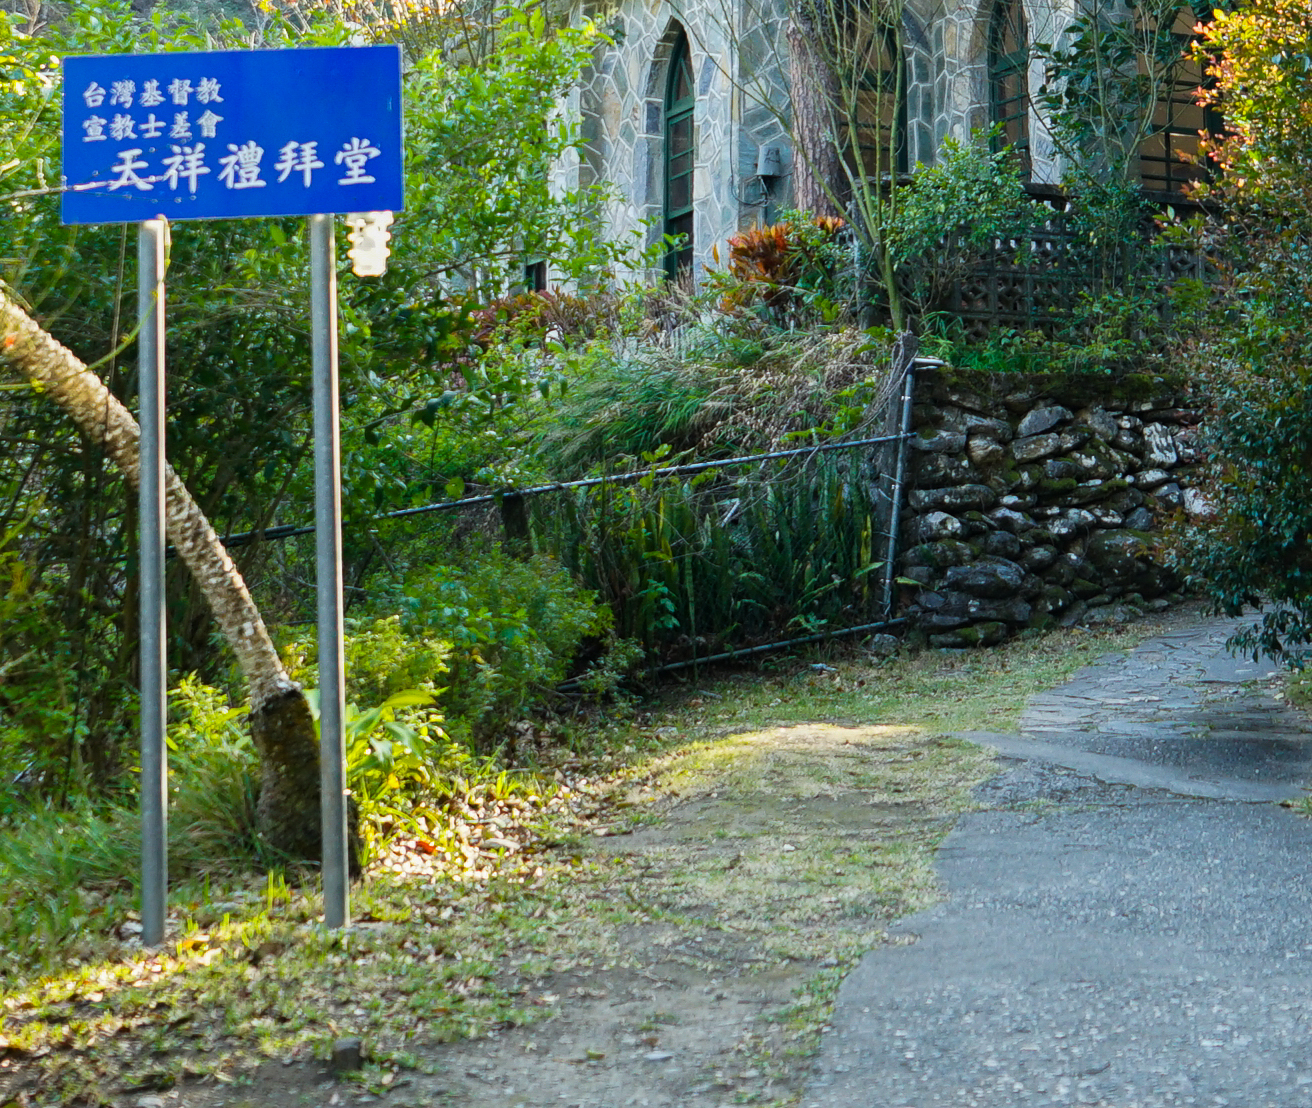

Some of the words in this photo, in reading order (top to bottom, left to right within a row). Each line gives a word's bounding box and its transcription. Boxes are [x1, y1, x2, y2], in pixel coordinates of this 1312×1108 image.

[83, 77, 224, 108] 台灣基督教
[82, 109, 224, 142] 宣教士差會
[109, 138, 381, 193] 天祥禮拜堂
